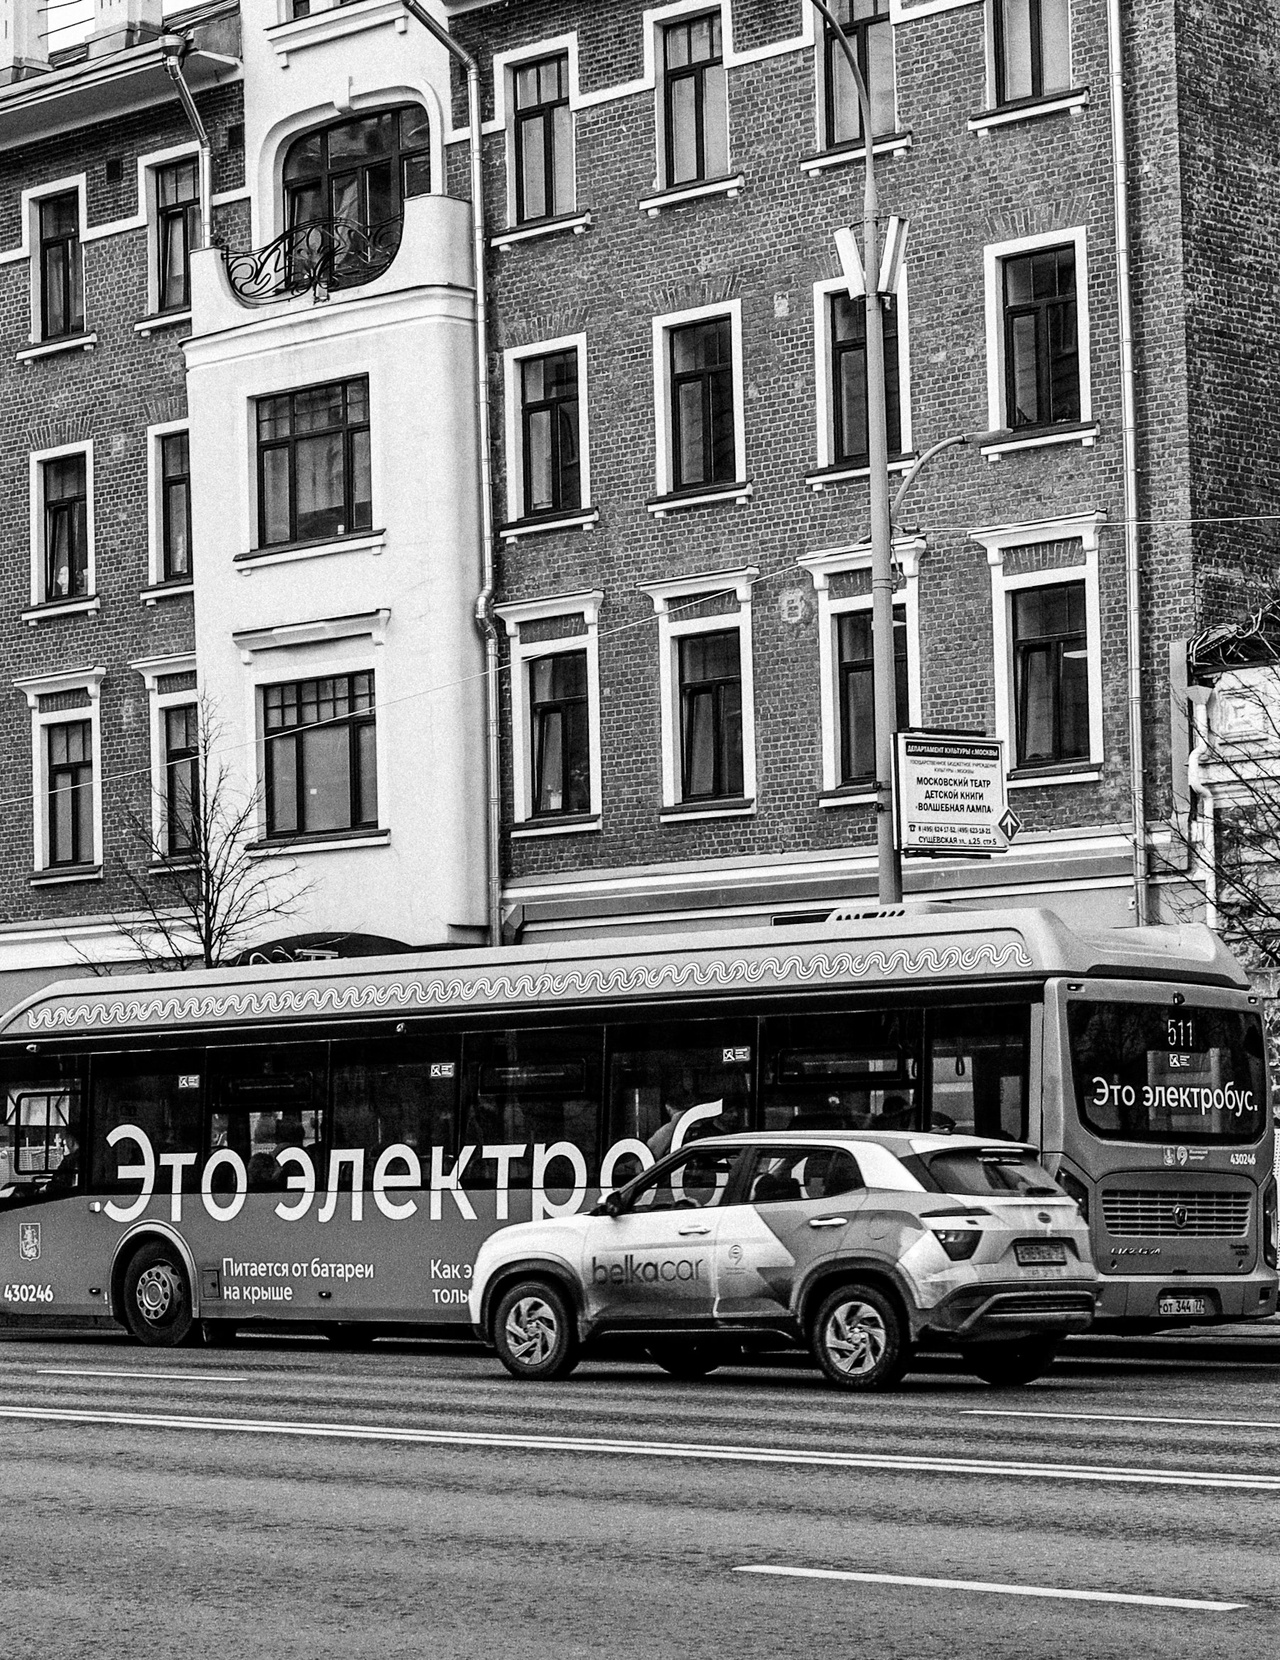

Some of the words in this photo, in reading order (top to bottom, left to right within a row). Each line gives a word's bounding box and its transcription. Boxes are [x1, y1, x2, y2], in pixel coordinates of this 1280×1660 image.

[916, 776, 969, 787] МОСКОВСКИЙ
[970, 778, 991, 788] ТЕАТР
[925, 788, 959, 800] ДЕТСКОЙ
[960, 791, 984, 801] КНИГИ
[918, 836, 958, 845] СУЩЕВСКАЯ
[1167, 1019, 1193, 1047] 511
[1092, 1076, 1136, 1106] Это
[1142, 1081, 1258, 1117] электробус.
[1230, 1153, 1257, 1165] 430246
[103, 1123, 248, 1222] Это
[222, 1257, 289, 1277] Питается
[291, 1262, 309, 1278] от
[311, 1257, 374, 1283] батареи
[430, 1259, 461, 1279] Как
[592, 1254, 704, 1285] belkacar
[3, 1284, 54, 1302] 430246
[223, 1286, 240, 1300] на
[243, 1285, 293, 1305] крыше
[431, 1288, 469, 1304] толь
